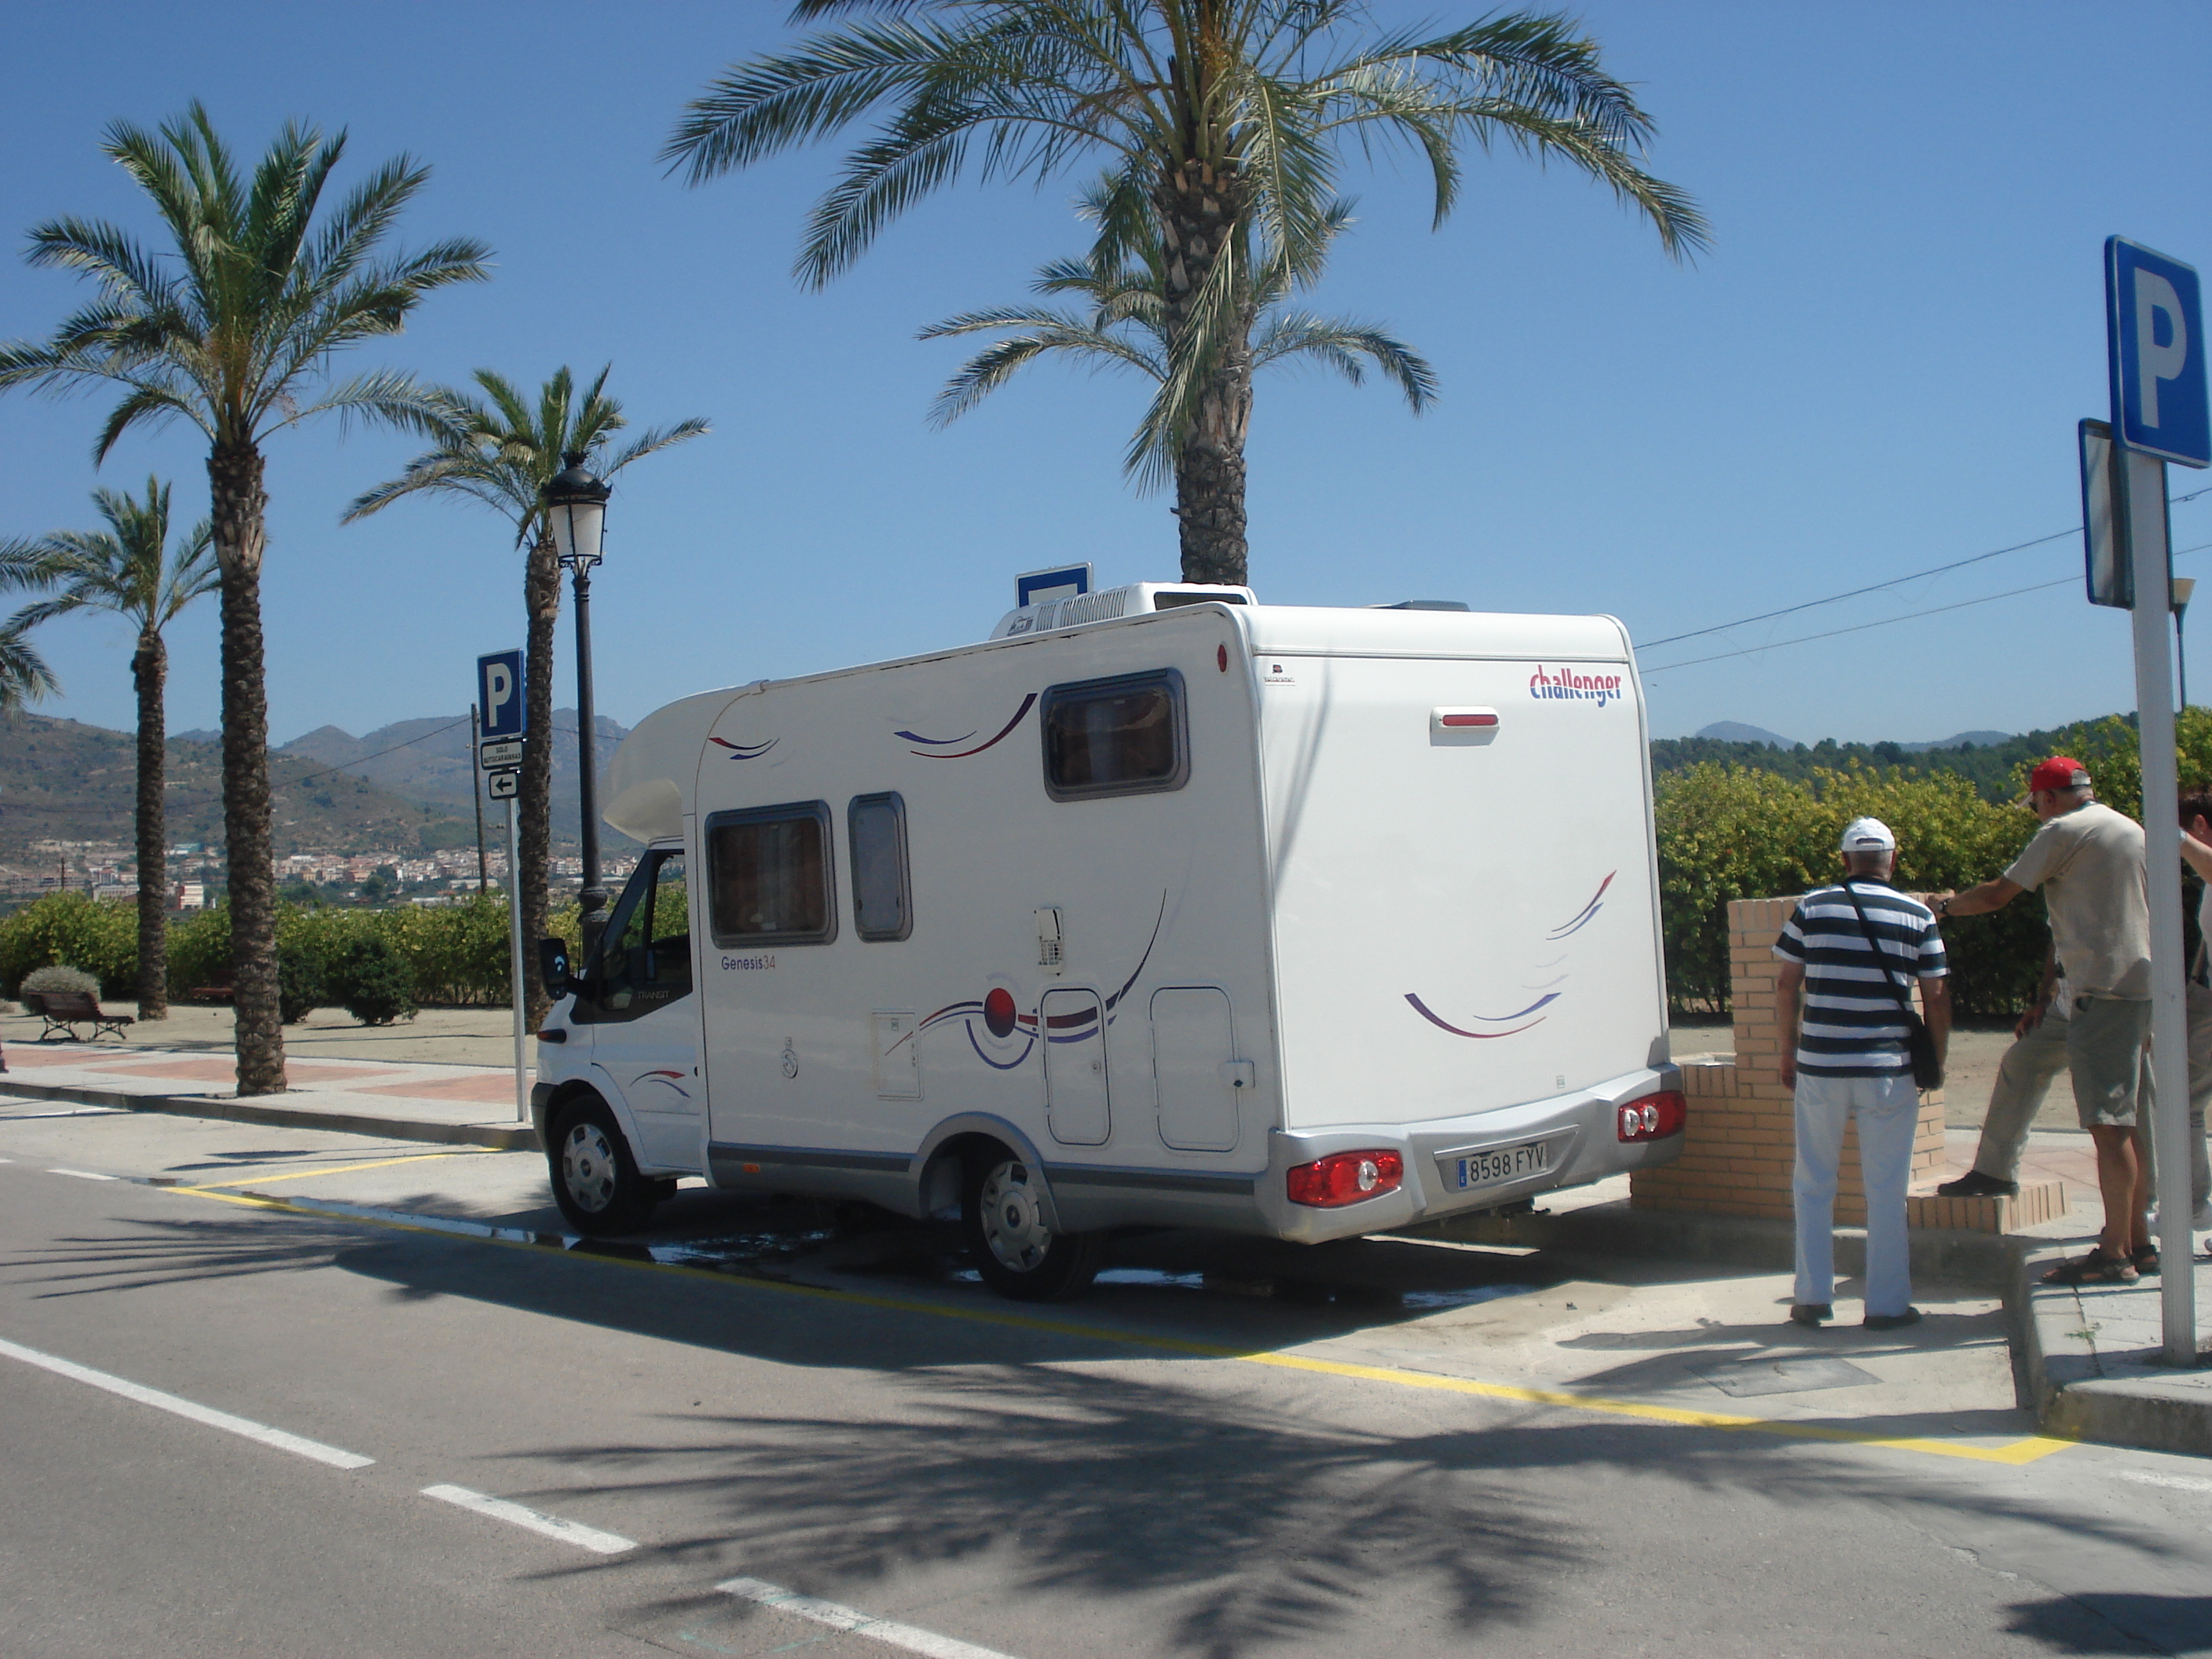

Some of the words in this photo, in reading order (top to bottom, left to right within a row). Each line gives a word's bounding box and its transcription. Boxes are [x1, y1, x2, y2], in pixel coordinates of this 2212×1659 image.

[2134, 266, 2187, 429] P
[485, 662, 512, 728] P
[1529, 664, 1621, 708] challenger
[638, 991, 670, 1000] TRANSIT
[1470, 1154, 1511, 1182] 8598
[1516, 1146, 1544, 1173] FYV
